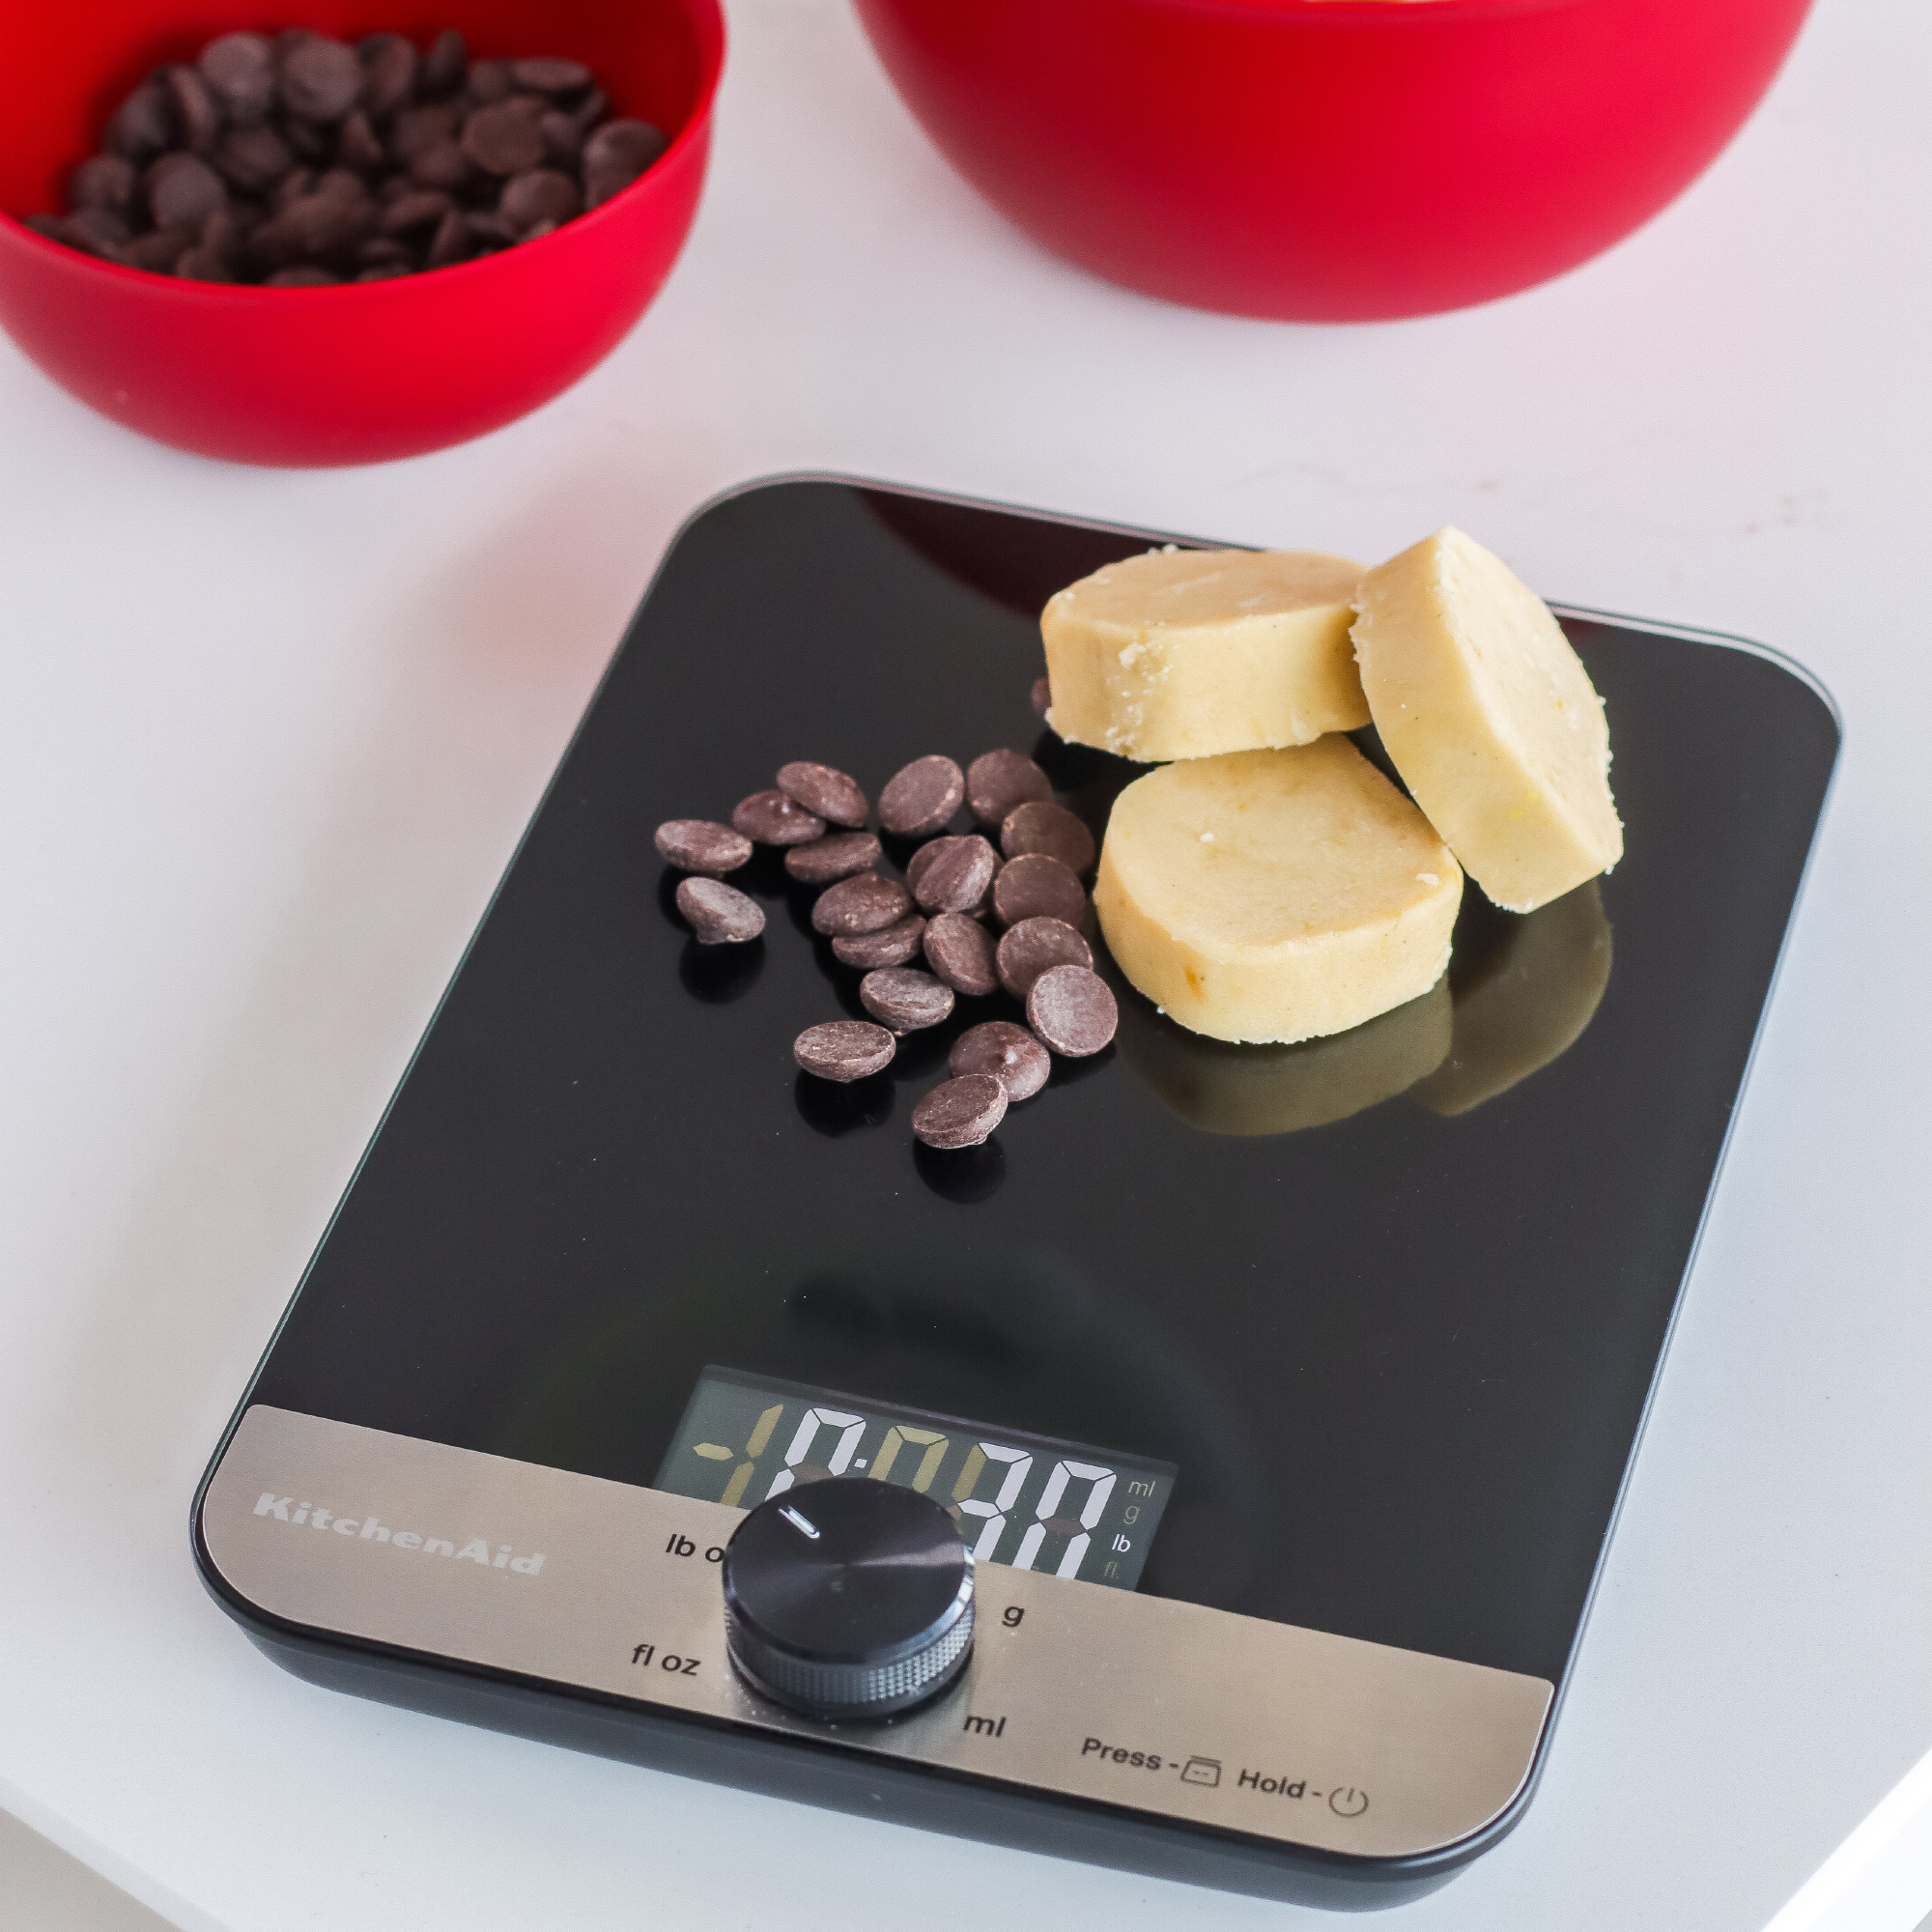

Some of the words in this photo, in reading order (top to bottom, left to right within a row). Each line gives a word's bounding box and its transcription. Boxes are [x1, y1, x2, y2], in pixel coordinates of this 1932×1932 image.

[1127, 1480, 1156, 1497] ml
[1122, 1505, 1141, 1525] g
[252, 1492, 546, 1577] KitchenAid
[665, 1533, 696, 1557] lb
[704, 1547, 725, 1563] o
[1111, 1533, 1131, 1553] lb
[1001, 1605, 1025, 1628] g
[631, 1643, 656, 1666] fl
[661, 1655, 702, 1676] oz
[962, 1715, 1007, 1739] ml
[1080, 1737, 1162, 1771] Press
[1236, 1768, 1307, 1800] Hold
